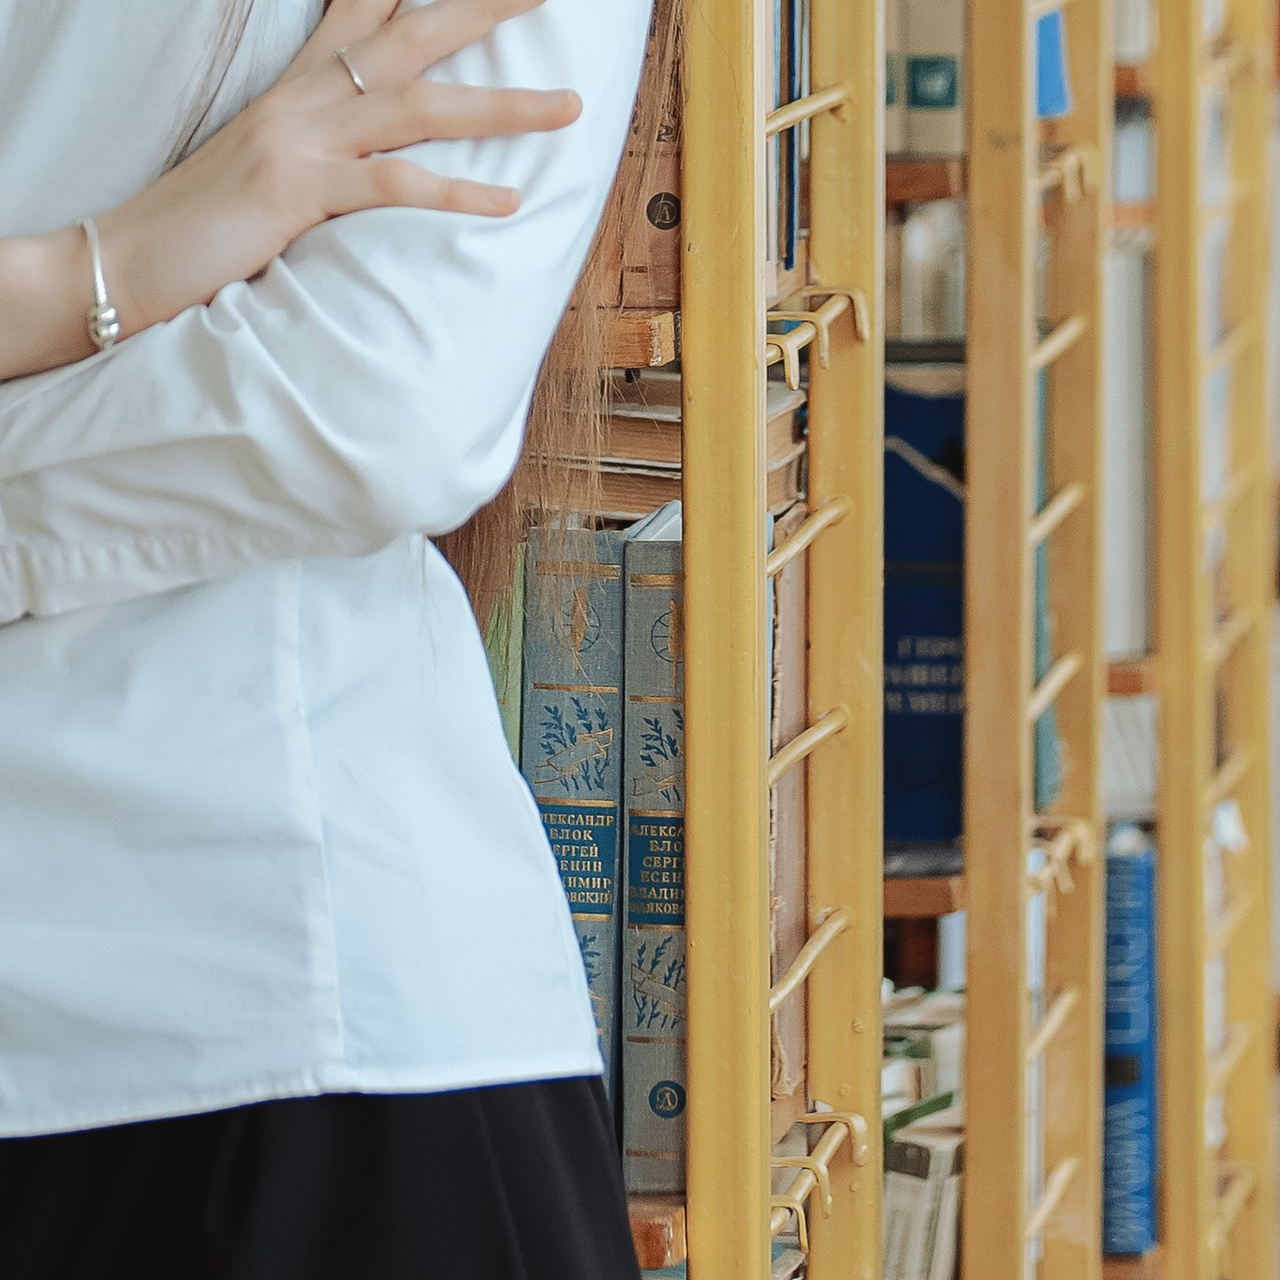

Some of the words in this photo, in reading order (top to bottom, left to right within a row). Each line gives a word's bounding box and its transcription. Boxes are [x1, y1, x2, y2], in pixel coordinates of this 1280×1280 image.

[549, 828, 593, 841] БЛОК
[553, 843, 599, 858] ЕРГЕЙ
[649, 840, 683, 852] БЛО
[560, 860, 602, 872] ЕНИН
[642, 856, 682, 869] СЕРГ
[640, 871, 683, 883] ЕСЕН
